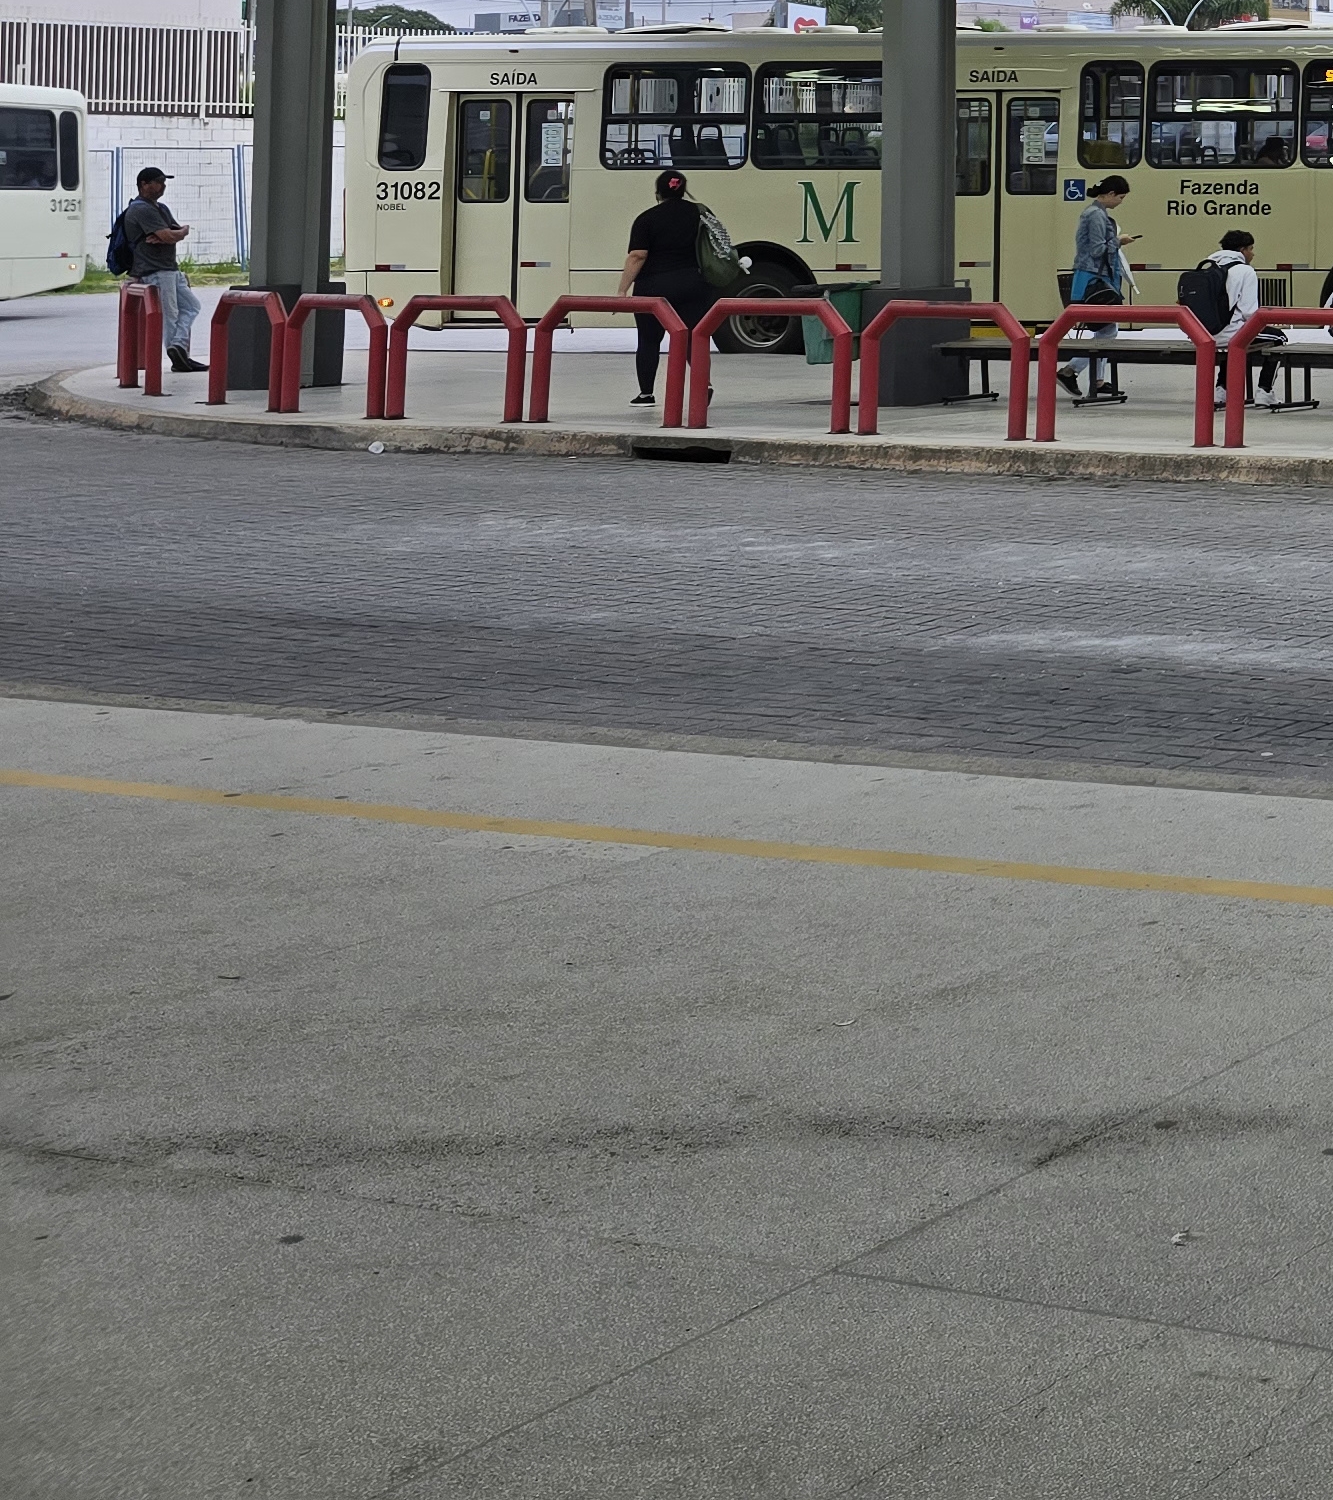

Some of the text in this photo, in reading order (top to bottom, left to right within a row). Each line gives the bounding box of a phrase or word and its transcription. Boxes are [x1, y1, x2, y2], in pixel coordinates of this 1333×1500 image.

[489, 68, 538, 86] SAÍDA
[376, 181, 441, 201] 31082
[1179, 179, 1260, 195] Fazenda
[50, 198, 82, 212] 31251
[796, 181, 861, 243] M
[1167, 200, 1272, 216] Rio Grande
